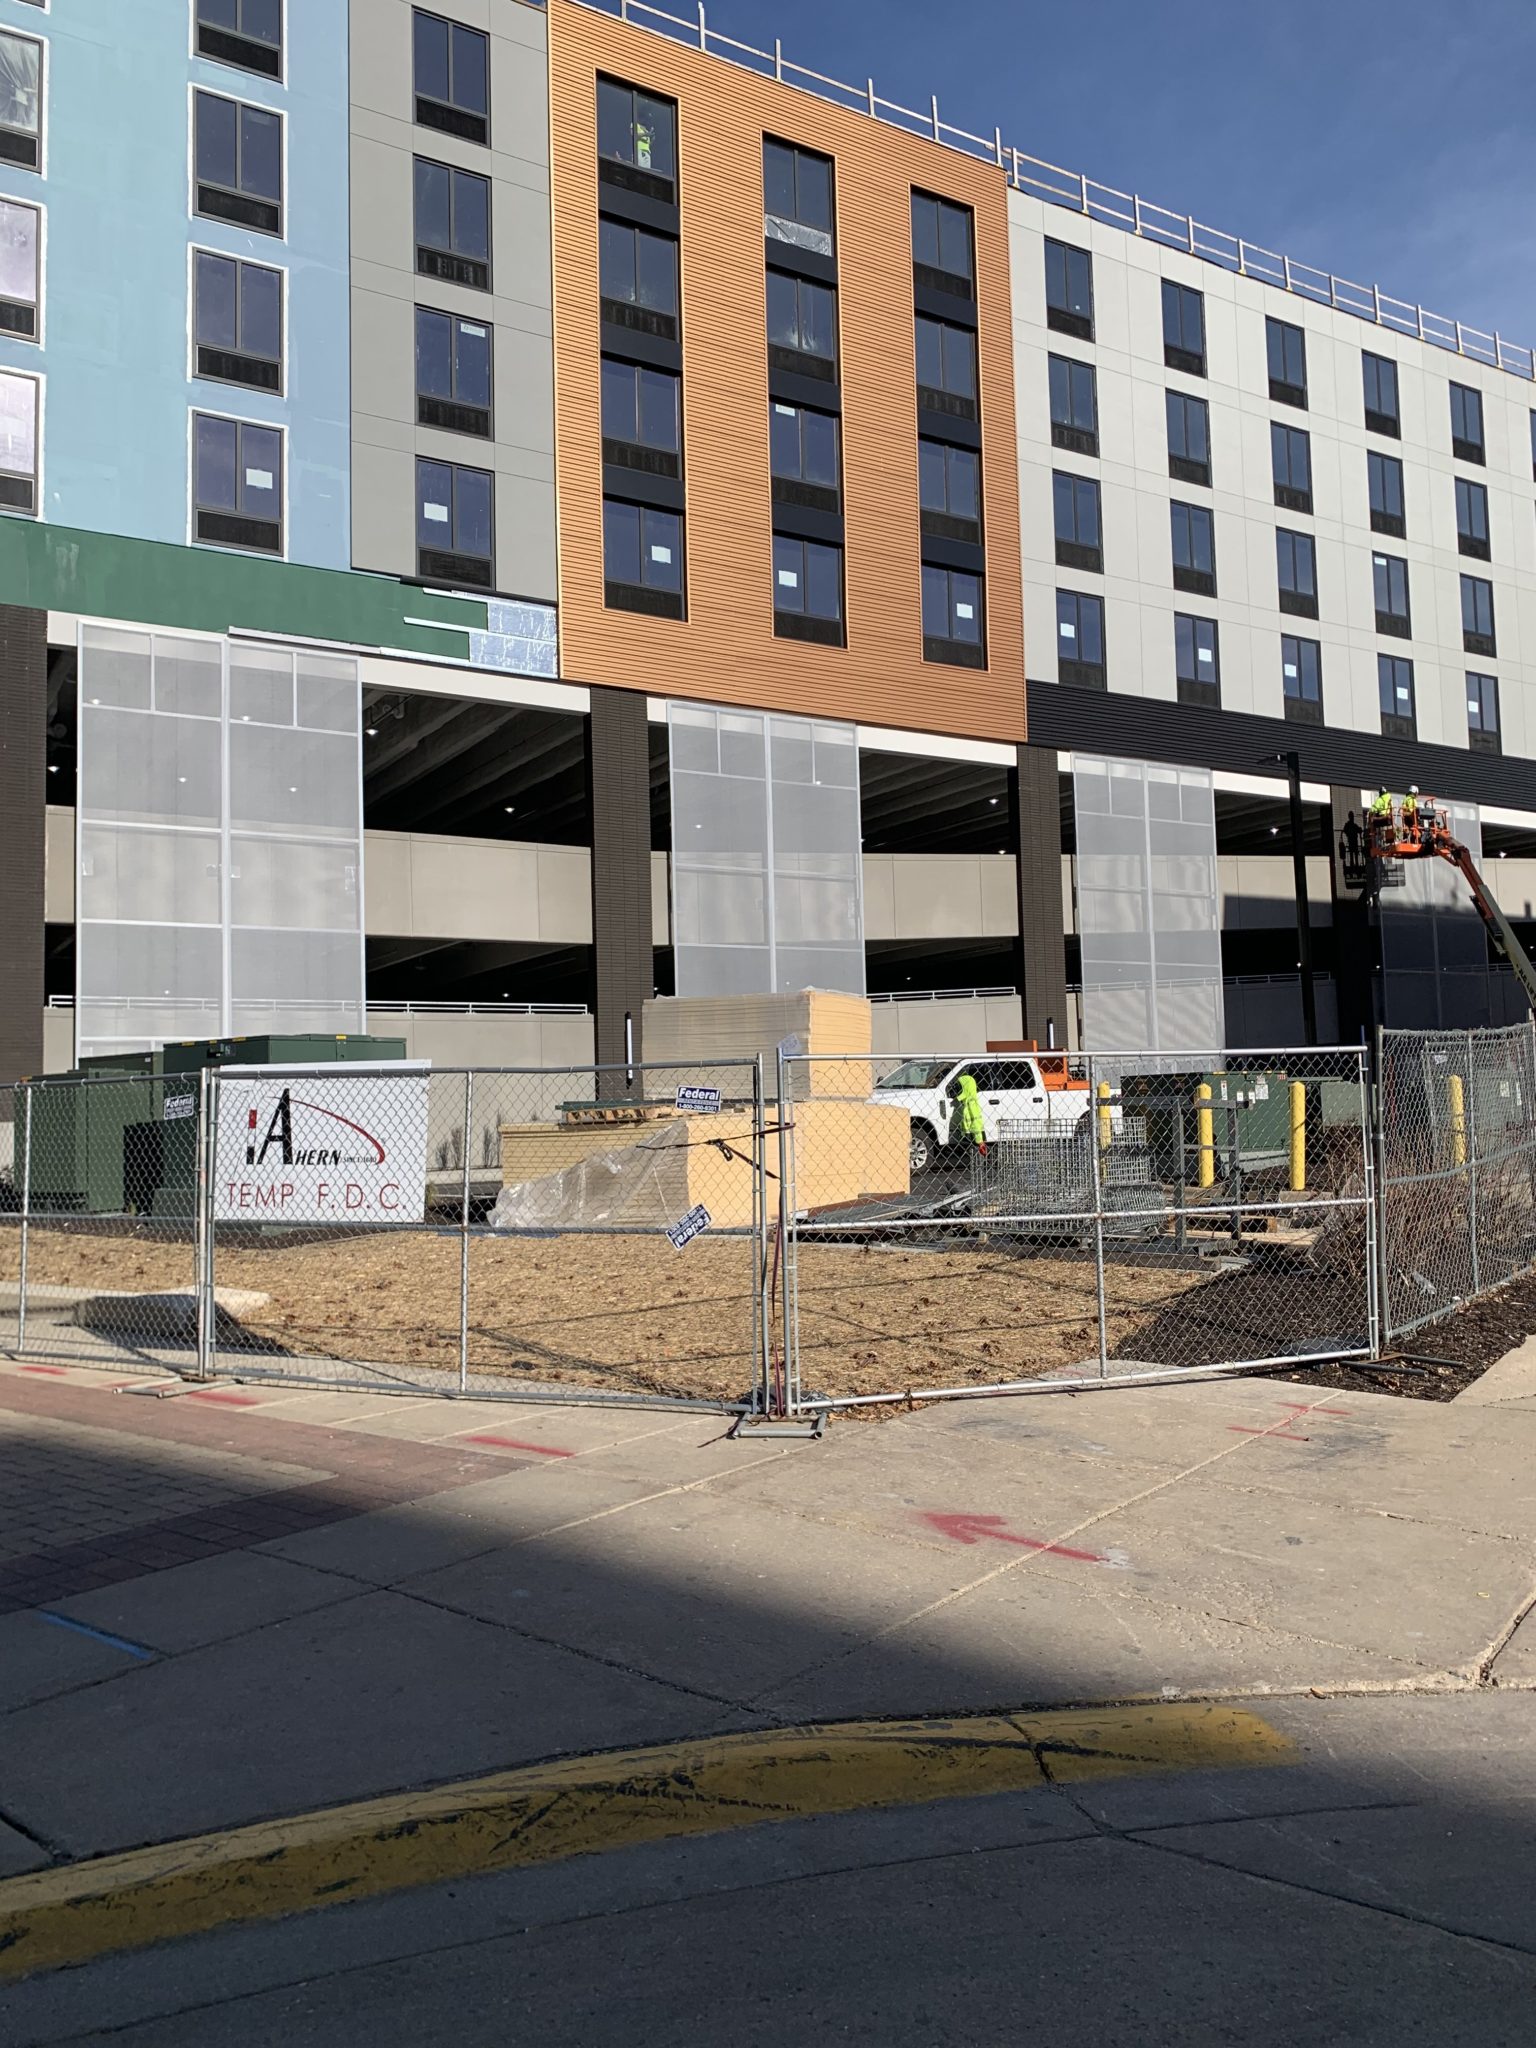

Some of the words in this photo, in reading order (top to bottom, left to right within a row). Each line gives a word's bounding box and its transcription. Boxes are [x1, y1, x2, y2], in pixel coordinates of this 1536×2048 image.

[679, 1087, 719, 1100] Federal
[257, 1087, 342, 1166] AHERN
[227, 1183, 294, 1208] TEMP
[675, 1213, 709, 1248] Federal
